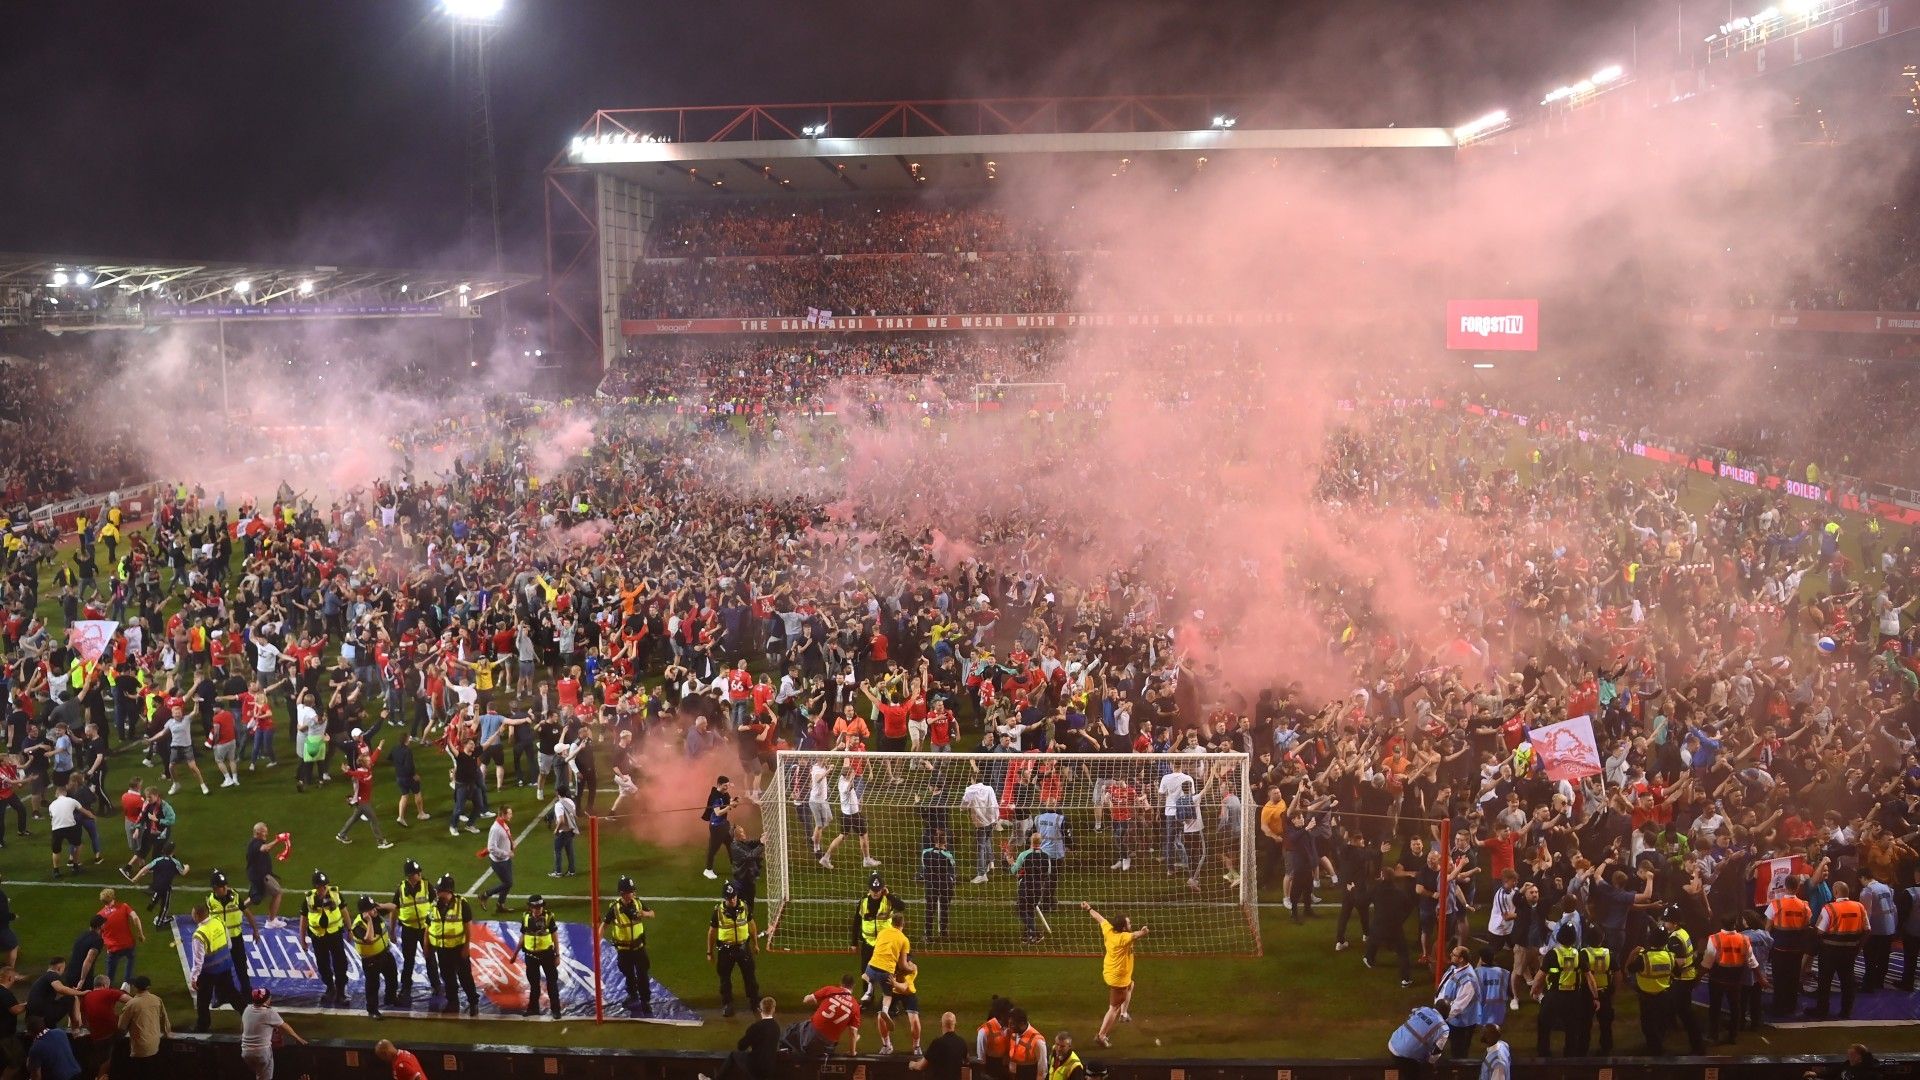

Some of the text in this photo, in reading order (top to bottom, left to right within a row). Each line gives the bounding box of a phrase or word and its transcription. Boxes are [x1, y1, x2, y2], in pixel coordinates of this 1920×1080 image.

[741, 320, 768, 330] THE
[876, 318, 913, 328] THAT
[926, 317, 948, 328] WE
[961, 317, 1003, 327] WEAR
[1016, 316, 1055, 327] WITH
[1068, 315, 1114, 326] PRIDE
[1461, 315, 1505, 336] FOREST
[1719, 463, 1755, 485] BOILERS
[1786, 480, 1821, 500] BOILER
[821, 997, 852, 1024] 37
